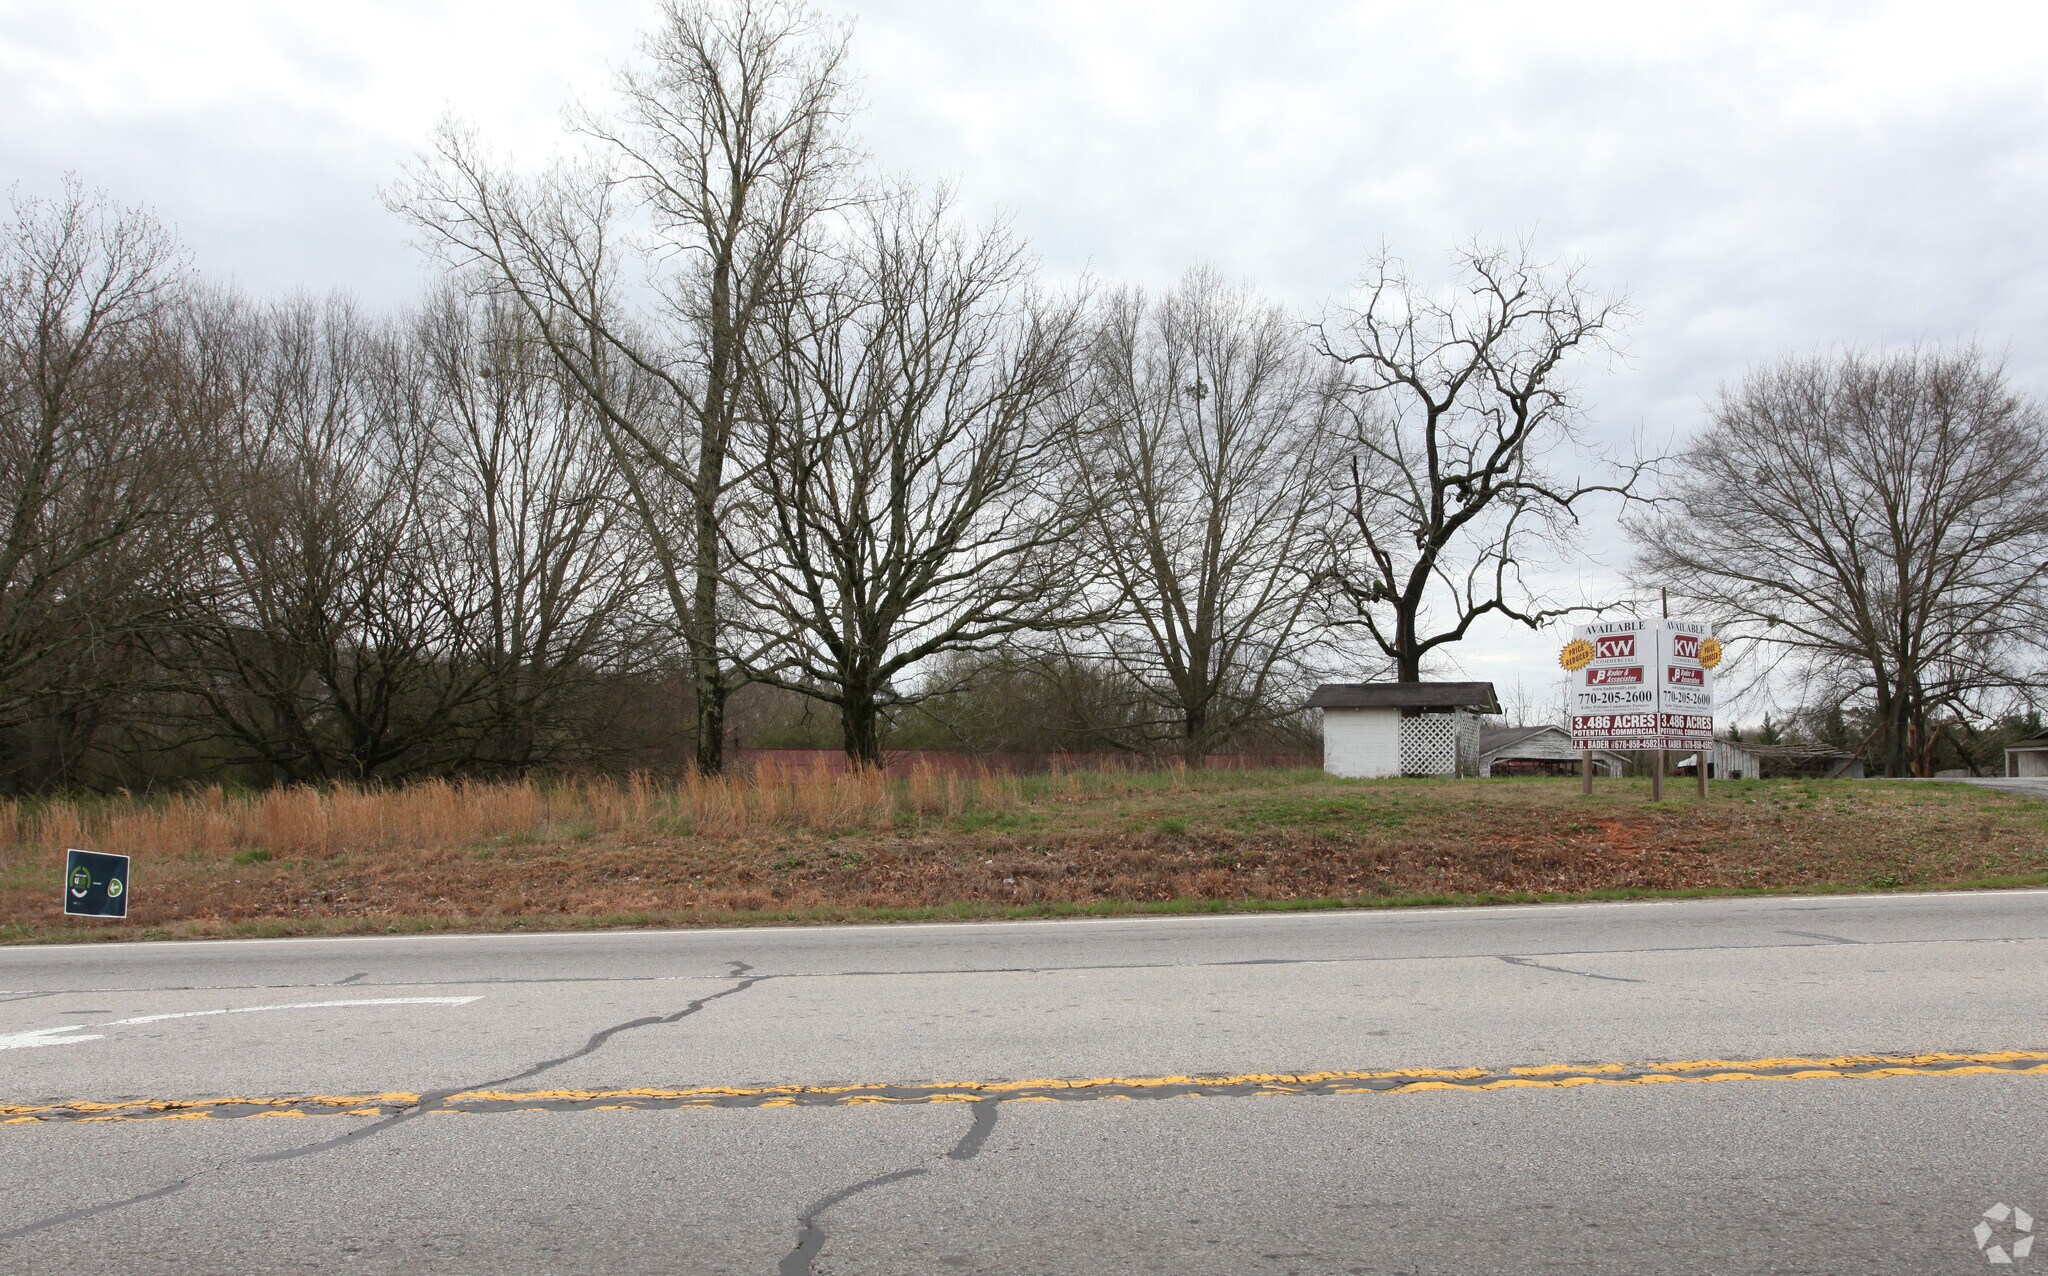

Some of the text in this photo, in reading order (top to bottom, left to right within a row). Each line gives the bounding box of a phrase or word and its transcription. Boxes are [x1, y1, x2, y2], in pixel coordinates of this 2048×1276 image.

[1585, 620, 1646, 635] AVAILABLE
[1666, 621, 1705, 634] AVAILABLE
[1568, 643, 1584, 657] PRICE
[1596, 639, 1634, 658] KW
[1674, 639, 1697, 657] KW
[1565, 650, 1590, 666] REDUCED
[1596, 657, 1634, 665] COMMERCIAL
[1607, 669, 1623, 677] Bader
[1578, 690, 1652, 704] 770-205-2600
[1663, 690, 1710, 705] 770-205-2600
[1575, 714, 1655, 729] 3.486 ACRES
[1661, 714, 1711, 729] 3.486 ACRES
[1611, 728, 1657, 736] COMMERCIAL
[1573, 740, 1586, 749] J.B.
[1587, 740, 1609, 749] BADER
[1614, 739, 1658, 749] 678-858-4582
